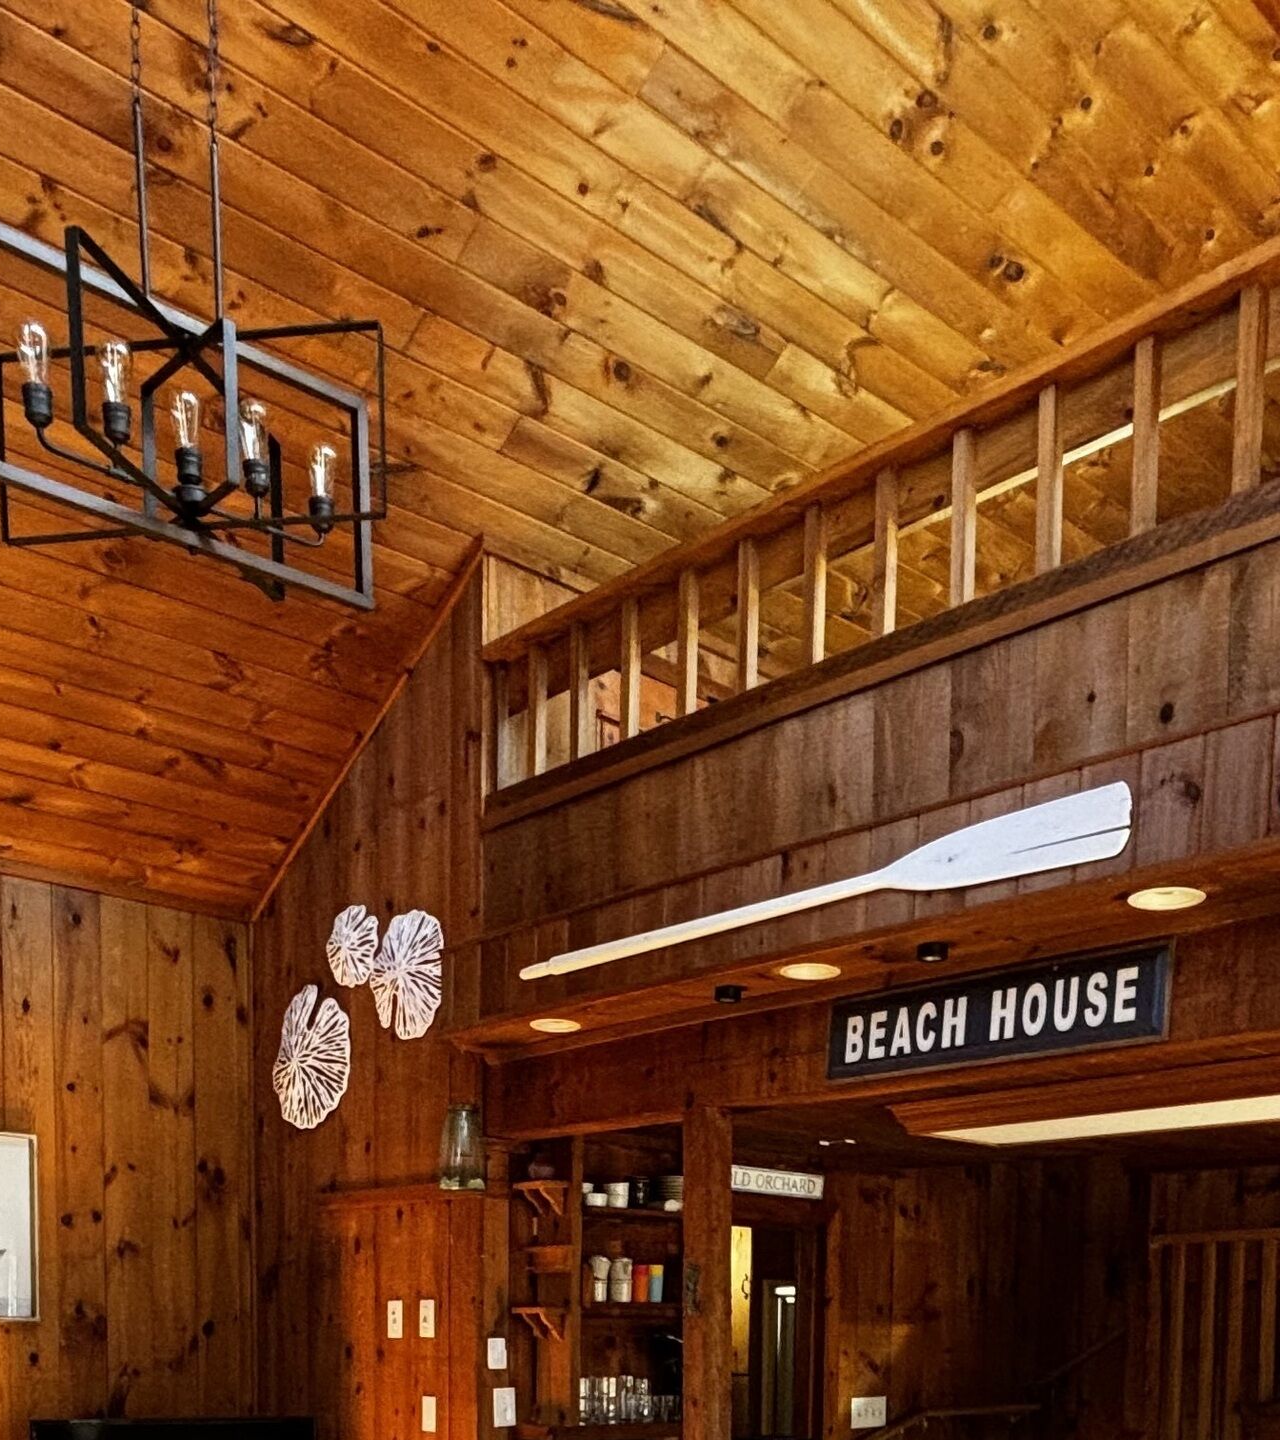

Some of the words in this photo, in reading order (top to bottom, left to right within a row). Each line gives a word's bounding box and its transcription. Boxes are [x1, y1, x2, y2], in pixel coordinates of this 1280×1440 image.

[843, 995, 968, 1065] BEACH
[988, 965, 1140, 1042] HOUSE
[732, 1171, 751, 1187] LD
[755, 1173, 817, 1195] ORCHARD
